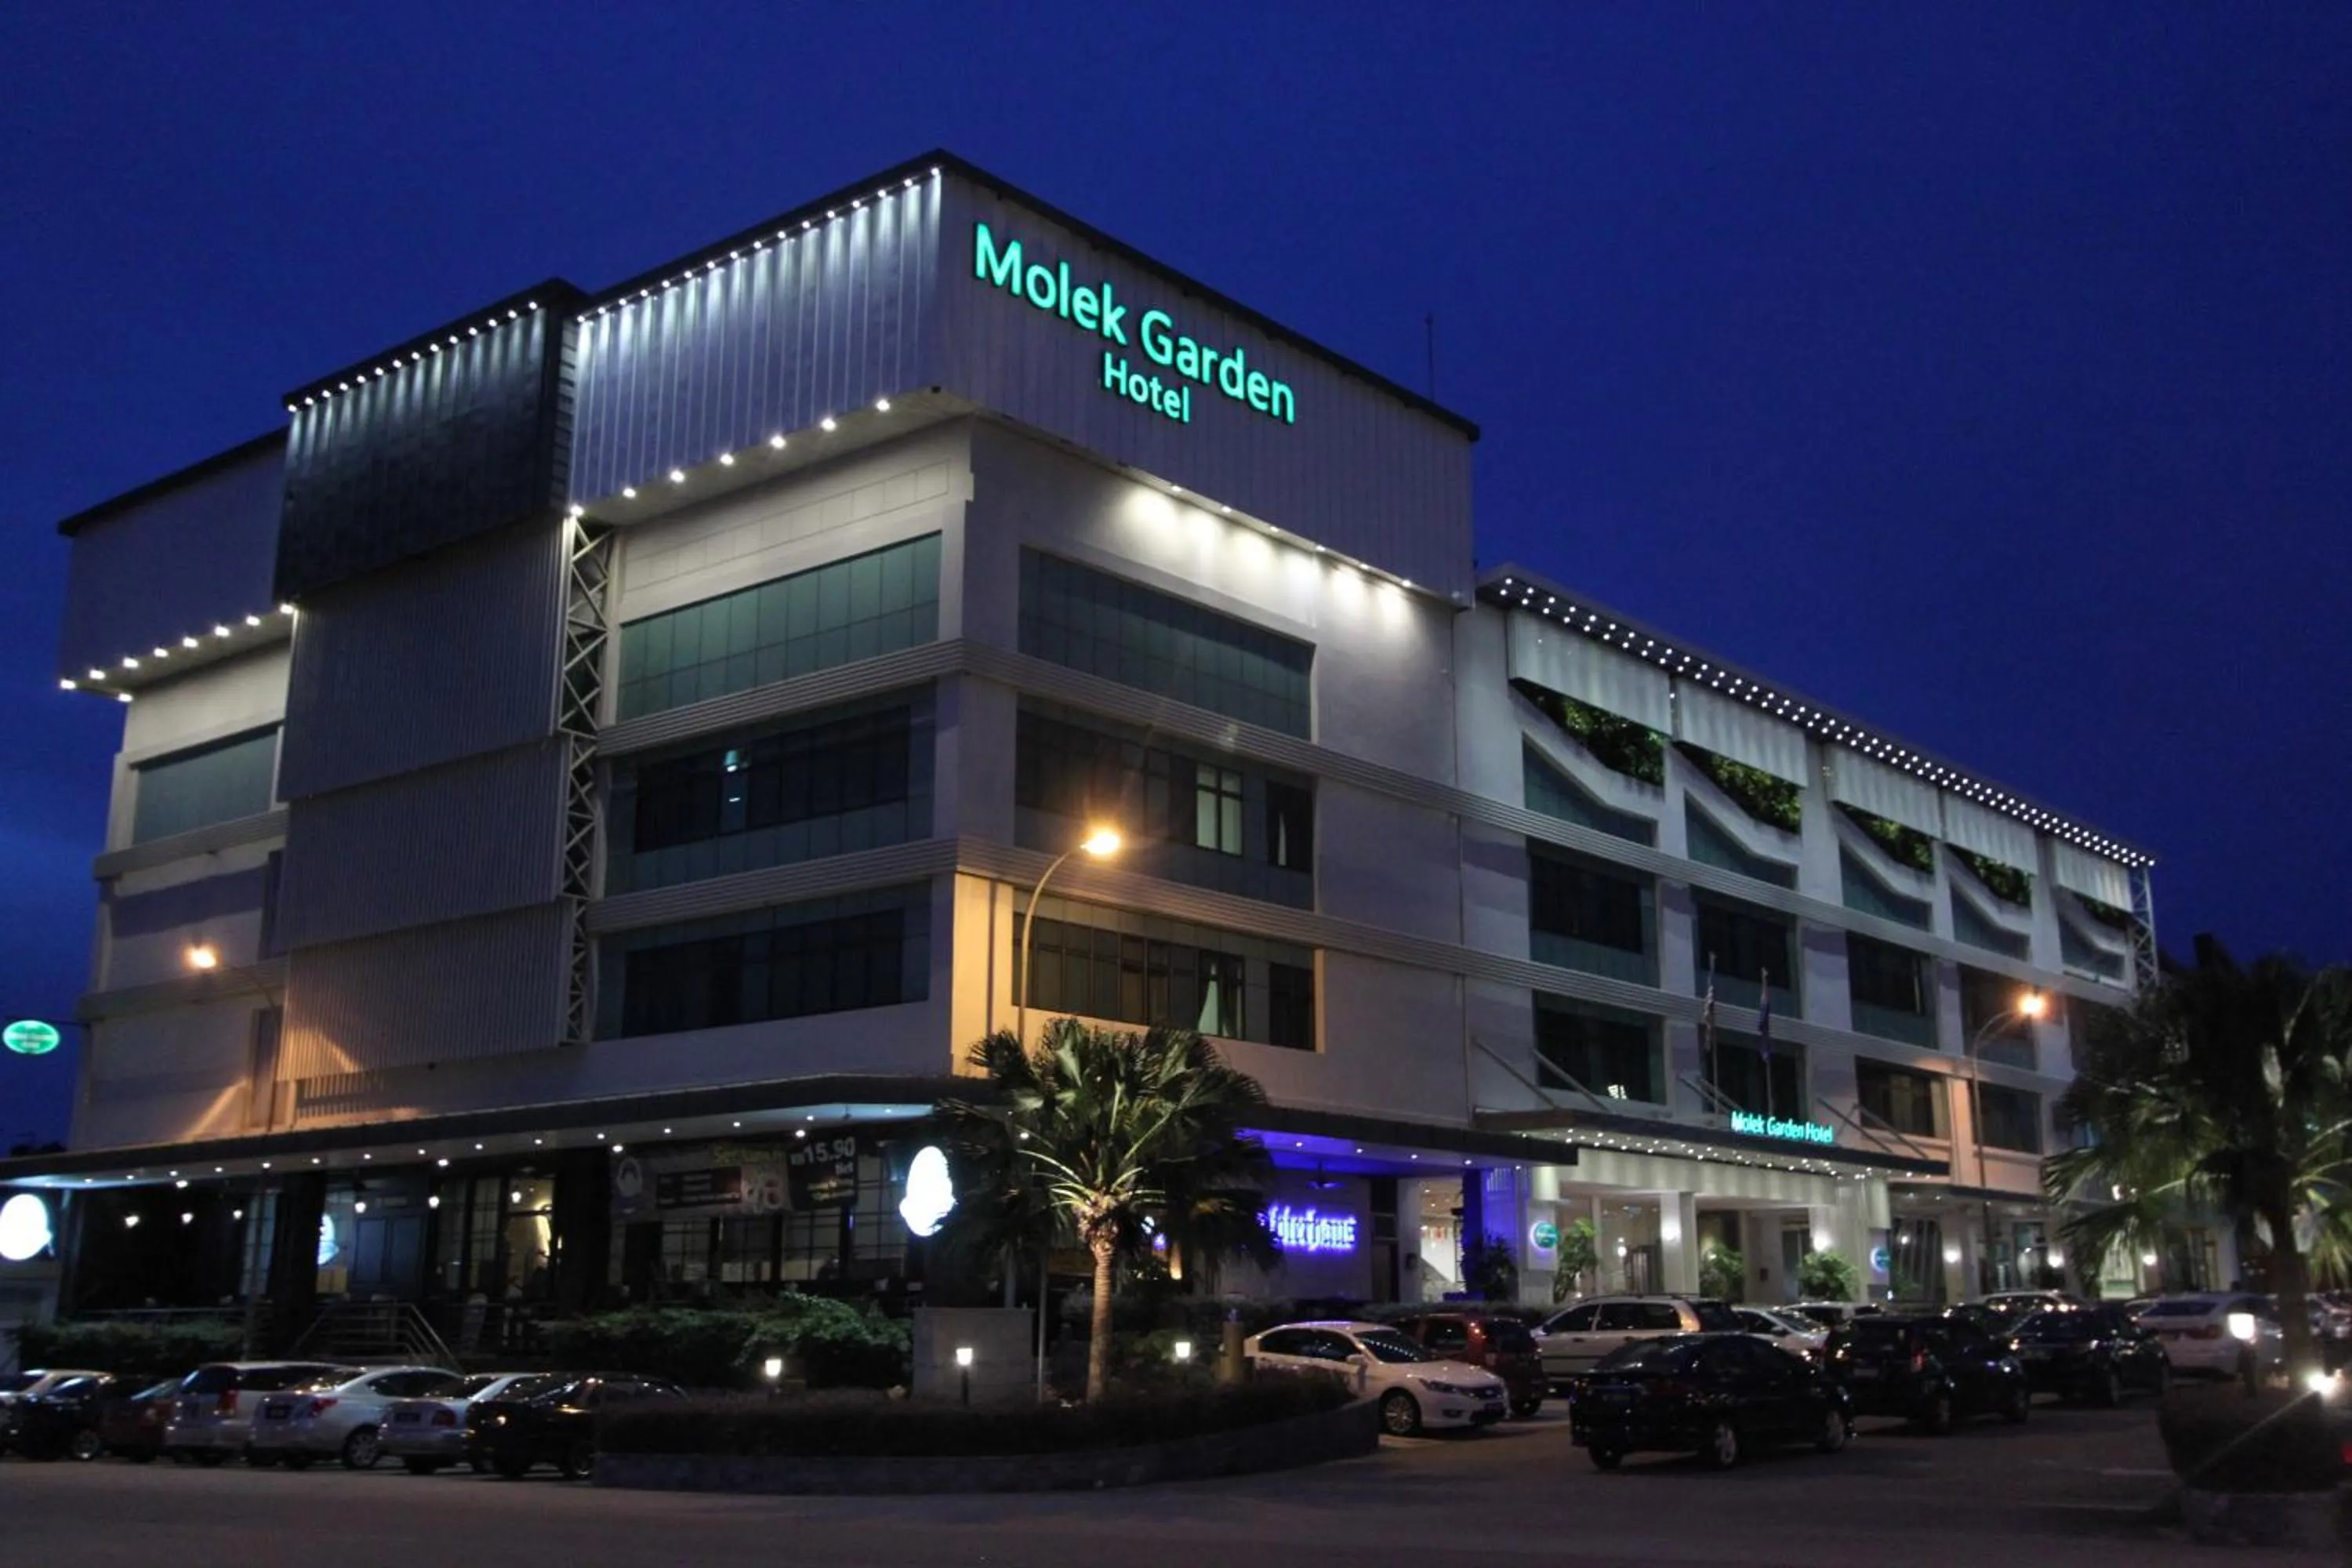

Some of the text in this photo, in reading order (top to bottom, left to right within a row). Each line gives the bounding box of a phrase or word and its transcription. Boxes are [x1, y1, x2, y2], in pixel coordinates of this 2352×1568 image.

[975, 223, 1295, 423] Molek Garden
[1104, 351, 1190, 423] Hotel
[1730, 1111, 1834, 1144] Molek Garden Hotel
